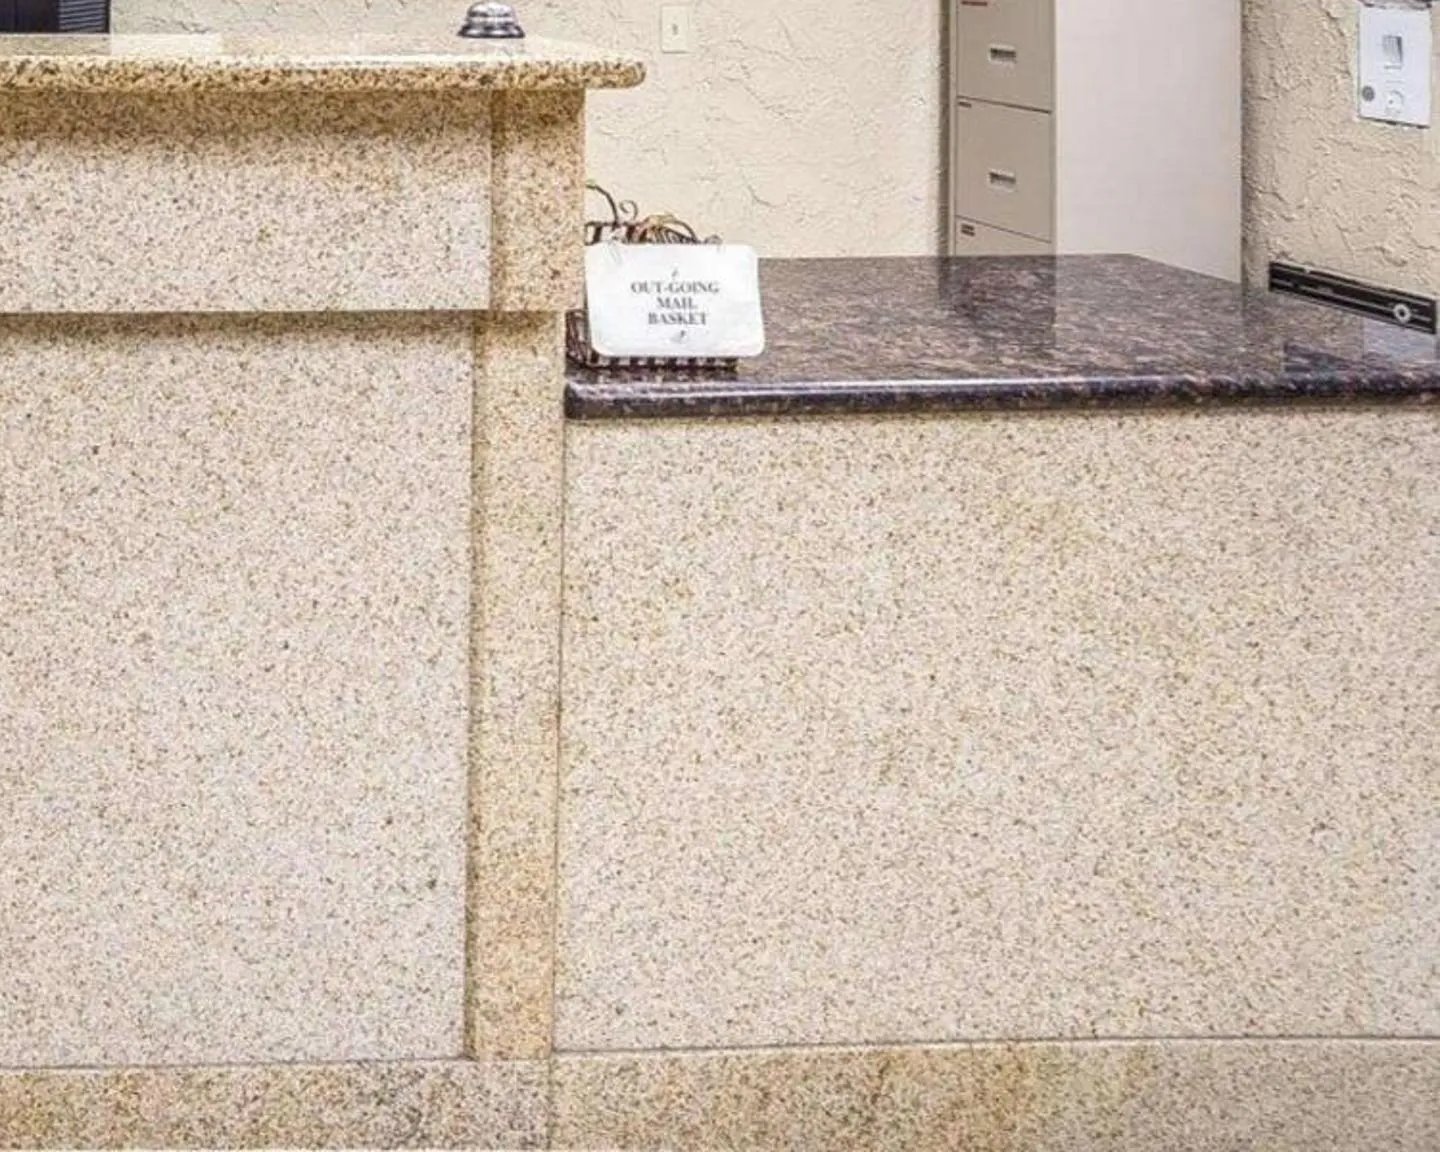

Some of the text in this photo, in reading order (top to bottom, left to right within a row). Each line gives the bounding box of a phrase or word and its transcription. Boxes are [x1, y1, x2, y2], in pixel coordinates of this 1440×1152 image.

[630, 281, 720, 294] OUT-GOING
[656, 297, 698, 310] MAIL
[647, 312, 707, 325] BASKET
